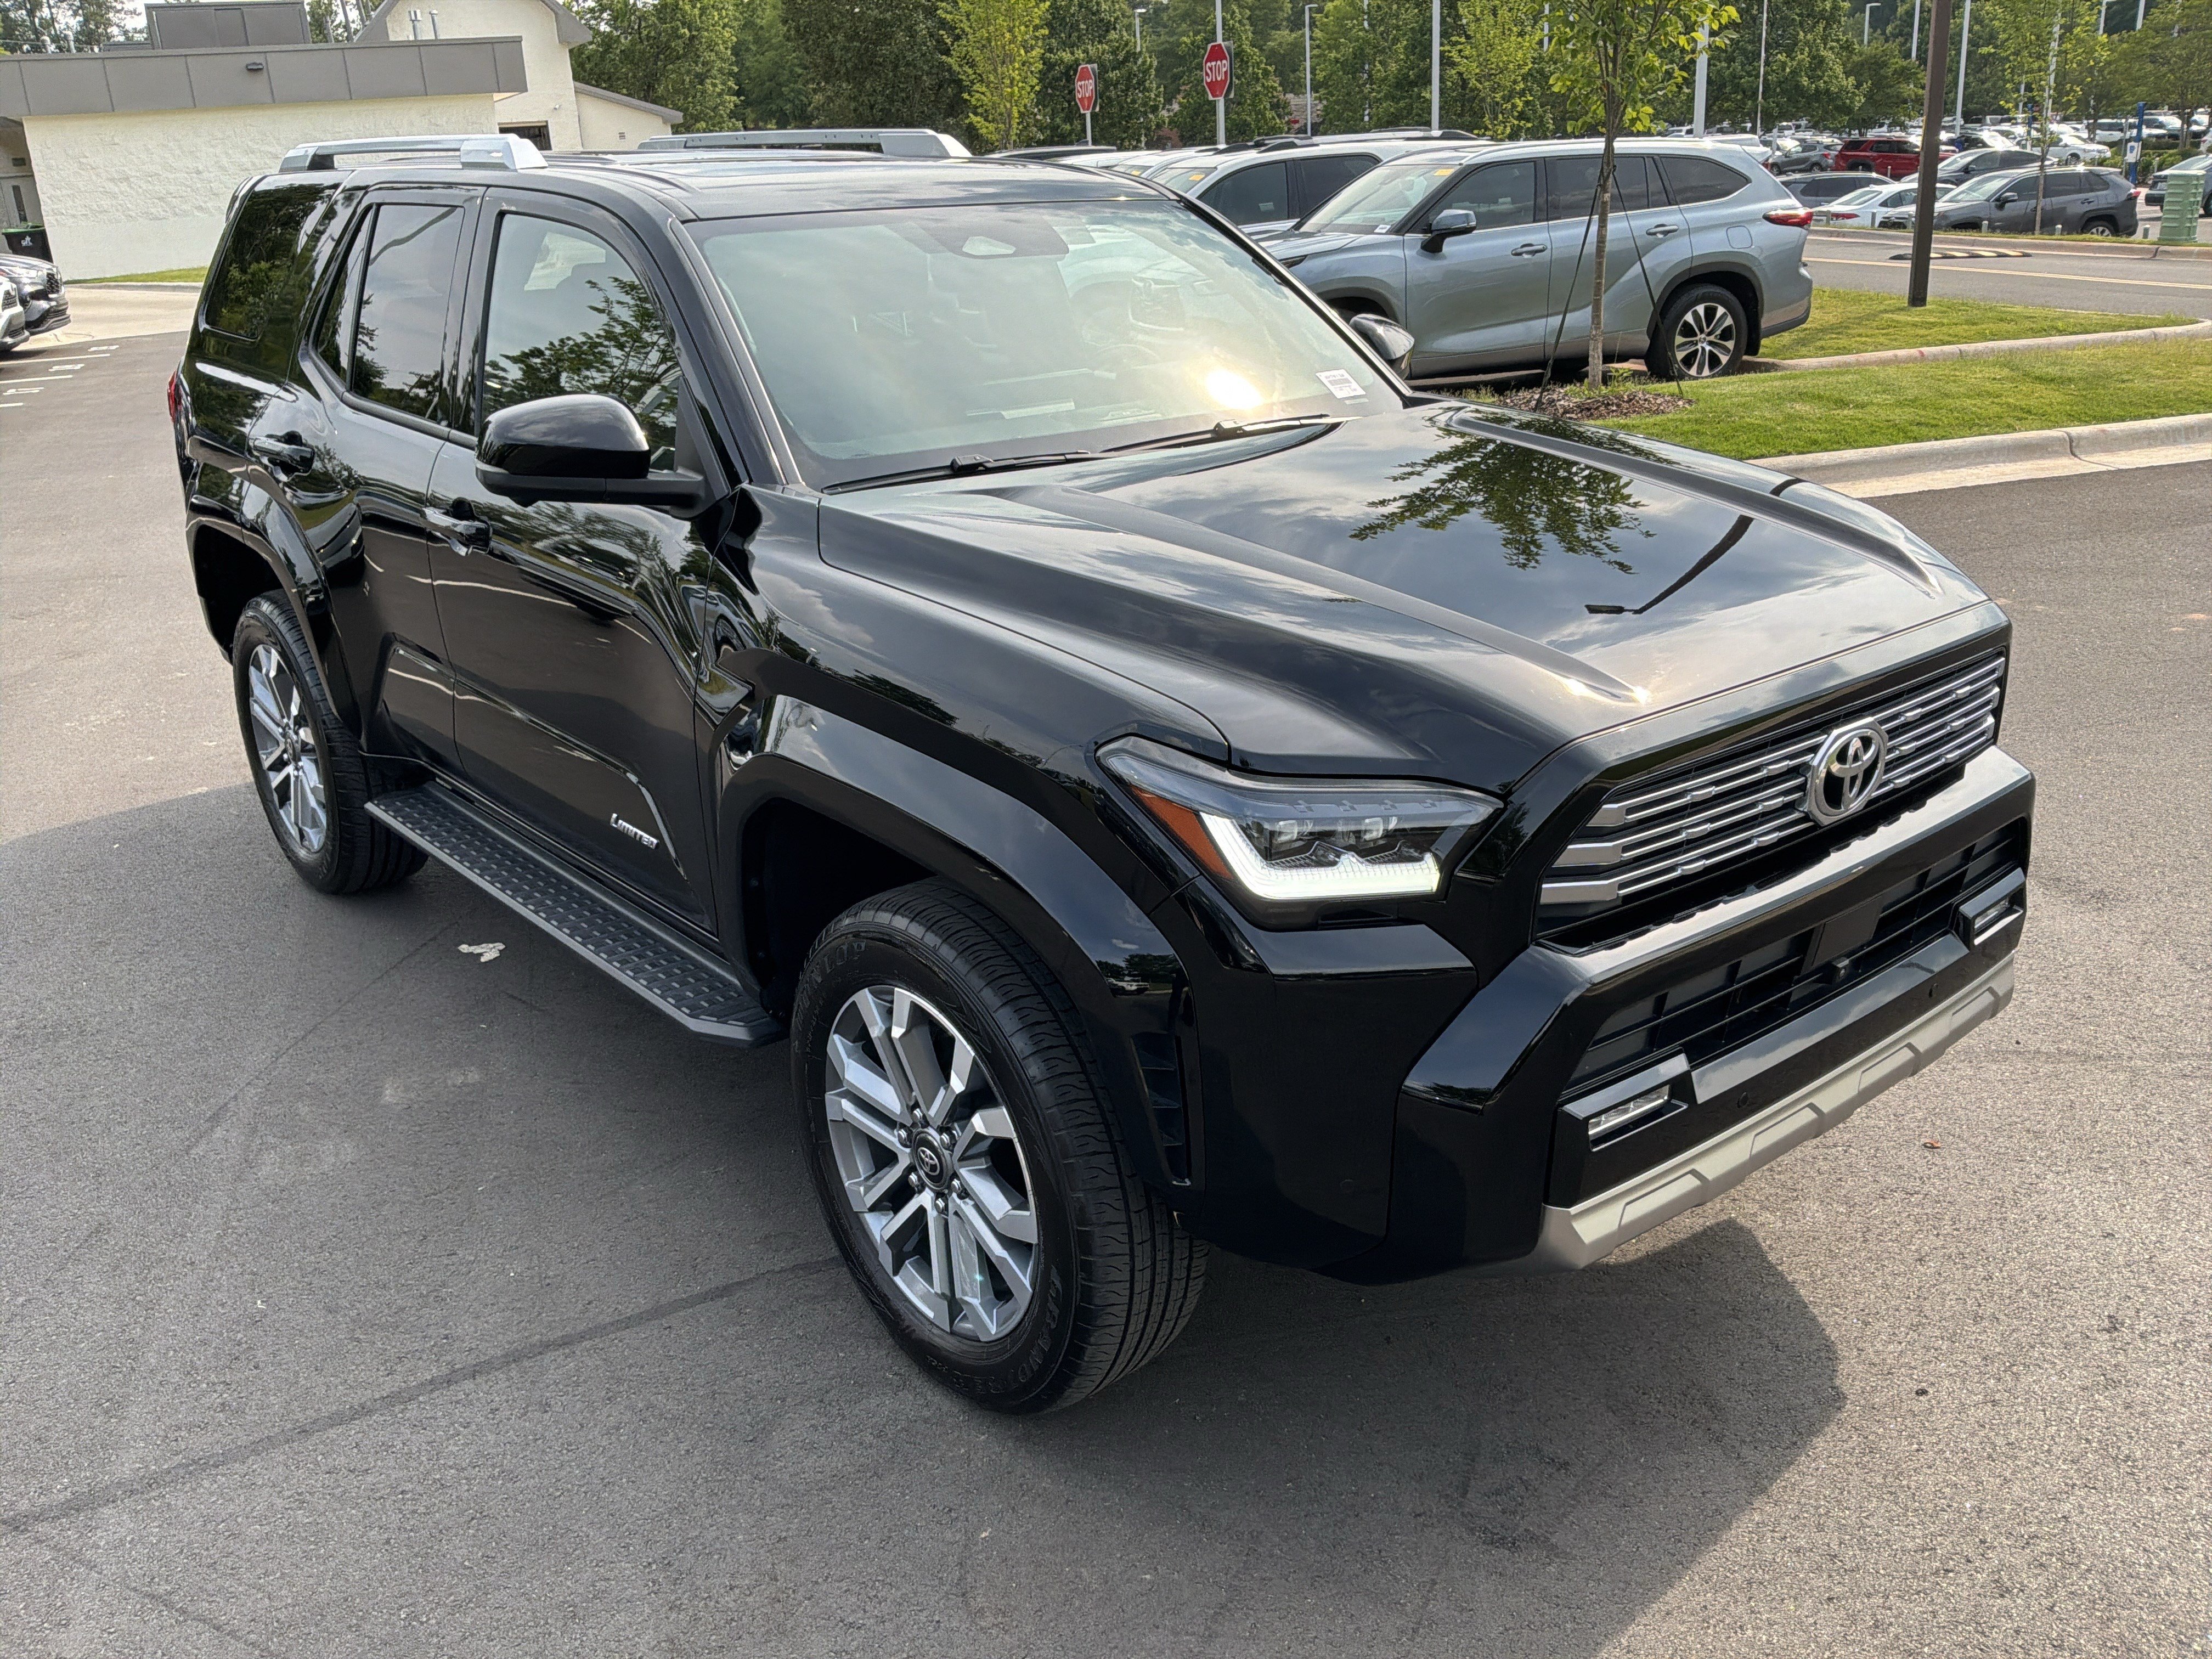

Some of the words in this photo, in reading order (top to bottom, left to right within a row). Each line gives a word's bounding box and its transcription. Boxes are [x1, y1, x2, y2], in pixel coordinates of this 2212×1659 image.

[1205, 60, 1228, 82] STOP
[1077, 80, 1093, 99] STOP
[610, 813, 658, 850] LIMITED
